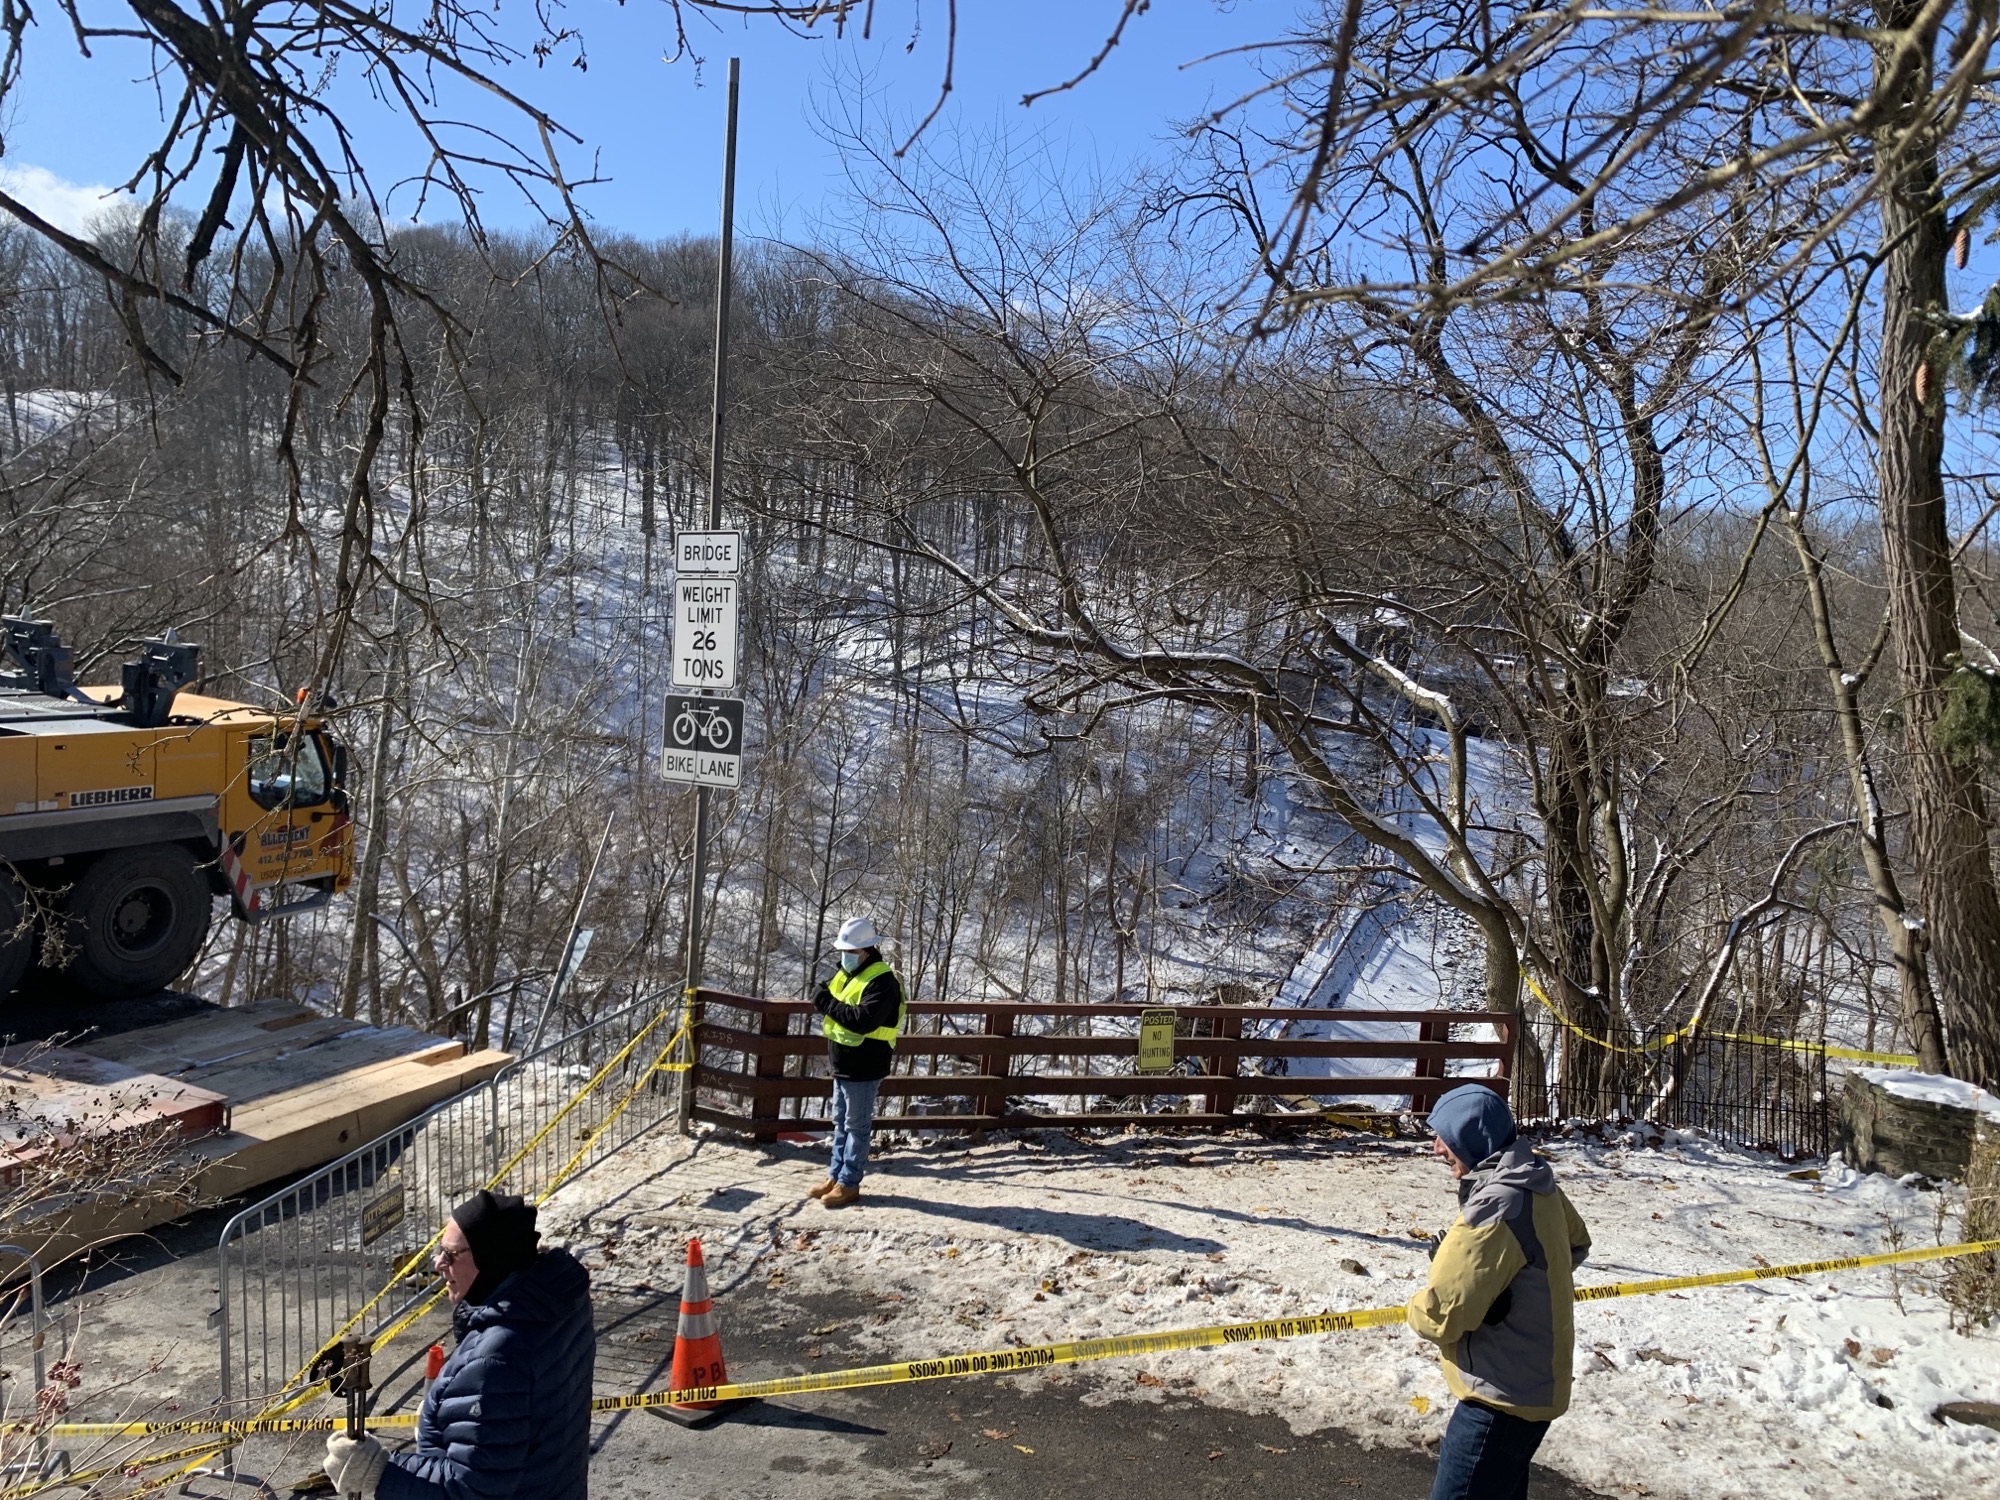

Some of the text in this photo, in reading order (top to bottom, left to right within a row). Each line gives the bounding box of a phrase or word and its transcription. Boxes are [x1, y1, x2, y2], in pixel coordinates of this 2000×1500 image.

[684, 545, 732, 561] BRIDGE
[682, 586, 731, 603] WEIGHT
[687, 606, 723, 623] LIMIT
[692, 630, 716, 651] 26
[683, 658, 724, 679] TONS
[666, 755, 735, 778] BIKE LANE
[70, 786, 153, 807] LIEBHERR
[1144, 1016, 1173, 1024] POSTED
[1153, 1031, 1161, 1041] NO
[1142, 1048, 1170, 1058] HUNTING
[363, 1190, 403, 1225] PITTSBURGH
[1574, 1289, 1588, 1301] LIN
[1223, 1315, 1354, 1343] POLICE LINE DO NOT CROSS
[908, 1349, 1055, 1379] POLICE LINE DO NOT CROSS
[596, 1385, 717, 1410] POLICE LINE DO NOT
